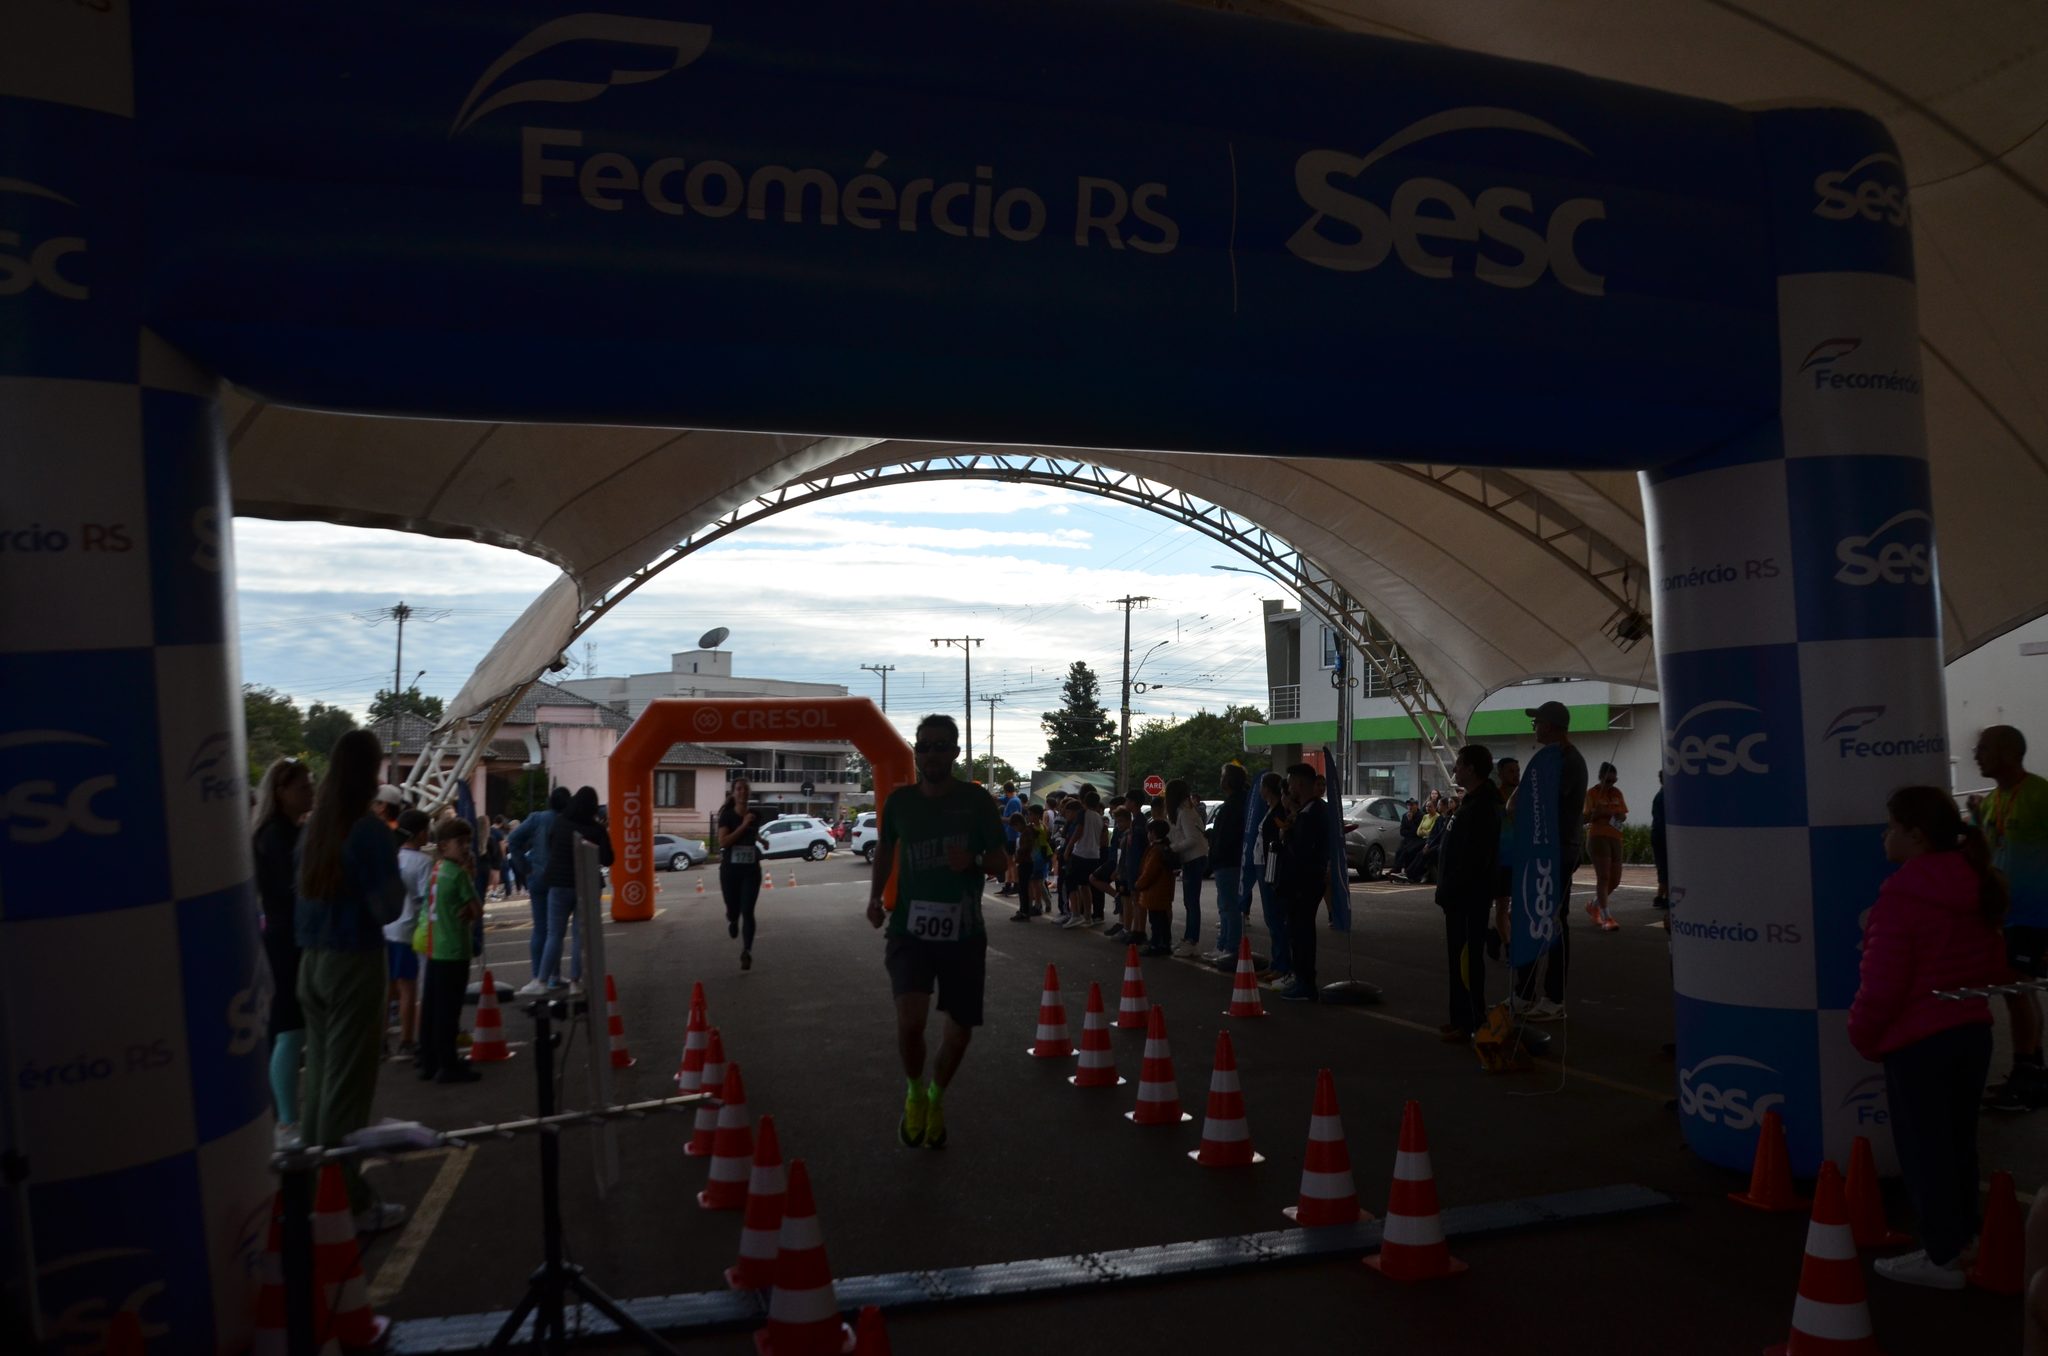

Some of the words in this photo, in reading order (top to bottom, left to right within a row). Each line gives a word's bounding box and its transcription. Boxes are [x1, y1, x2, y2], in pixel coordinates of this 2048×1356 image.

[520, 126, 1047, 242] Fecomércio
[1075, 175, 1180, 255] RS
[1285, 147, 1608, 297] Sesc
[82, 523, 134, 552] RS
[1745, 558, 1780, 580] RS
[730, 708, 837, 729] CRESOL
[0, 773, 122, 843] sc
[624, 784, 641, 874] CRESOL
[1529, 858, 1554, 942] Sesc
[914, 915, 954, 937] 509
[1766, 923, 1802, 944] RS
[126, 1038, 174, 1072] RS
